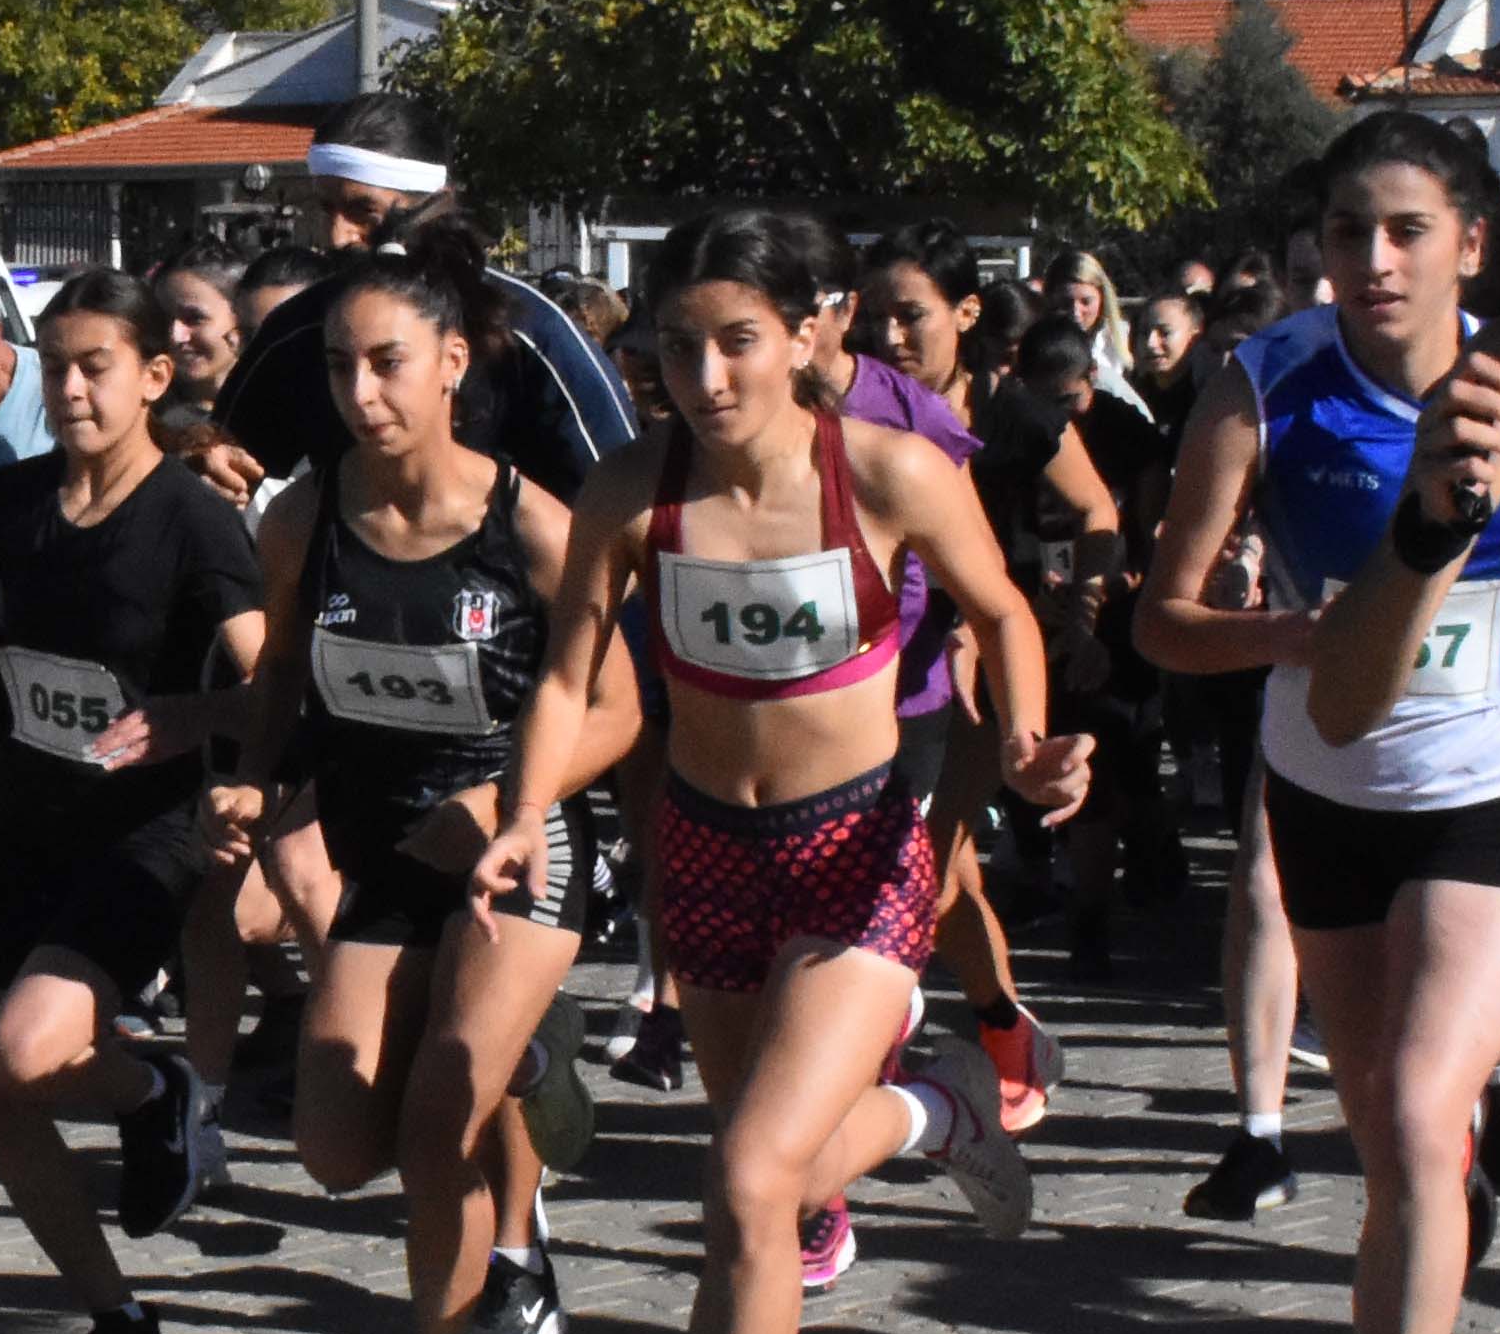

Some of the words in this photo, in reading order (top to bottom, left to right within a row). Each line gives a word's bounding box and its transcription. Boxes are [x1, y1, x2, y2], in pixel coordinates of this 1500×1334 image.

[701, 601, 825, 645] 194
[29, 682, 110, 734] 055
[347, 671, 454, 706] 193
